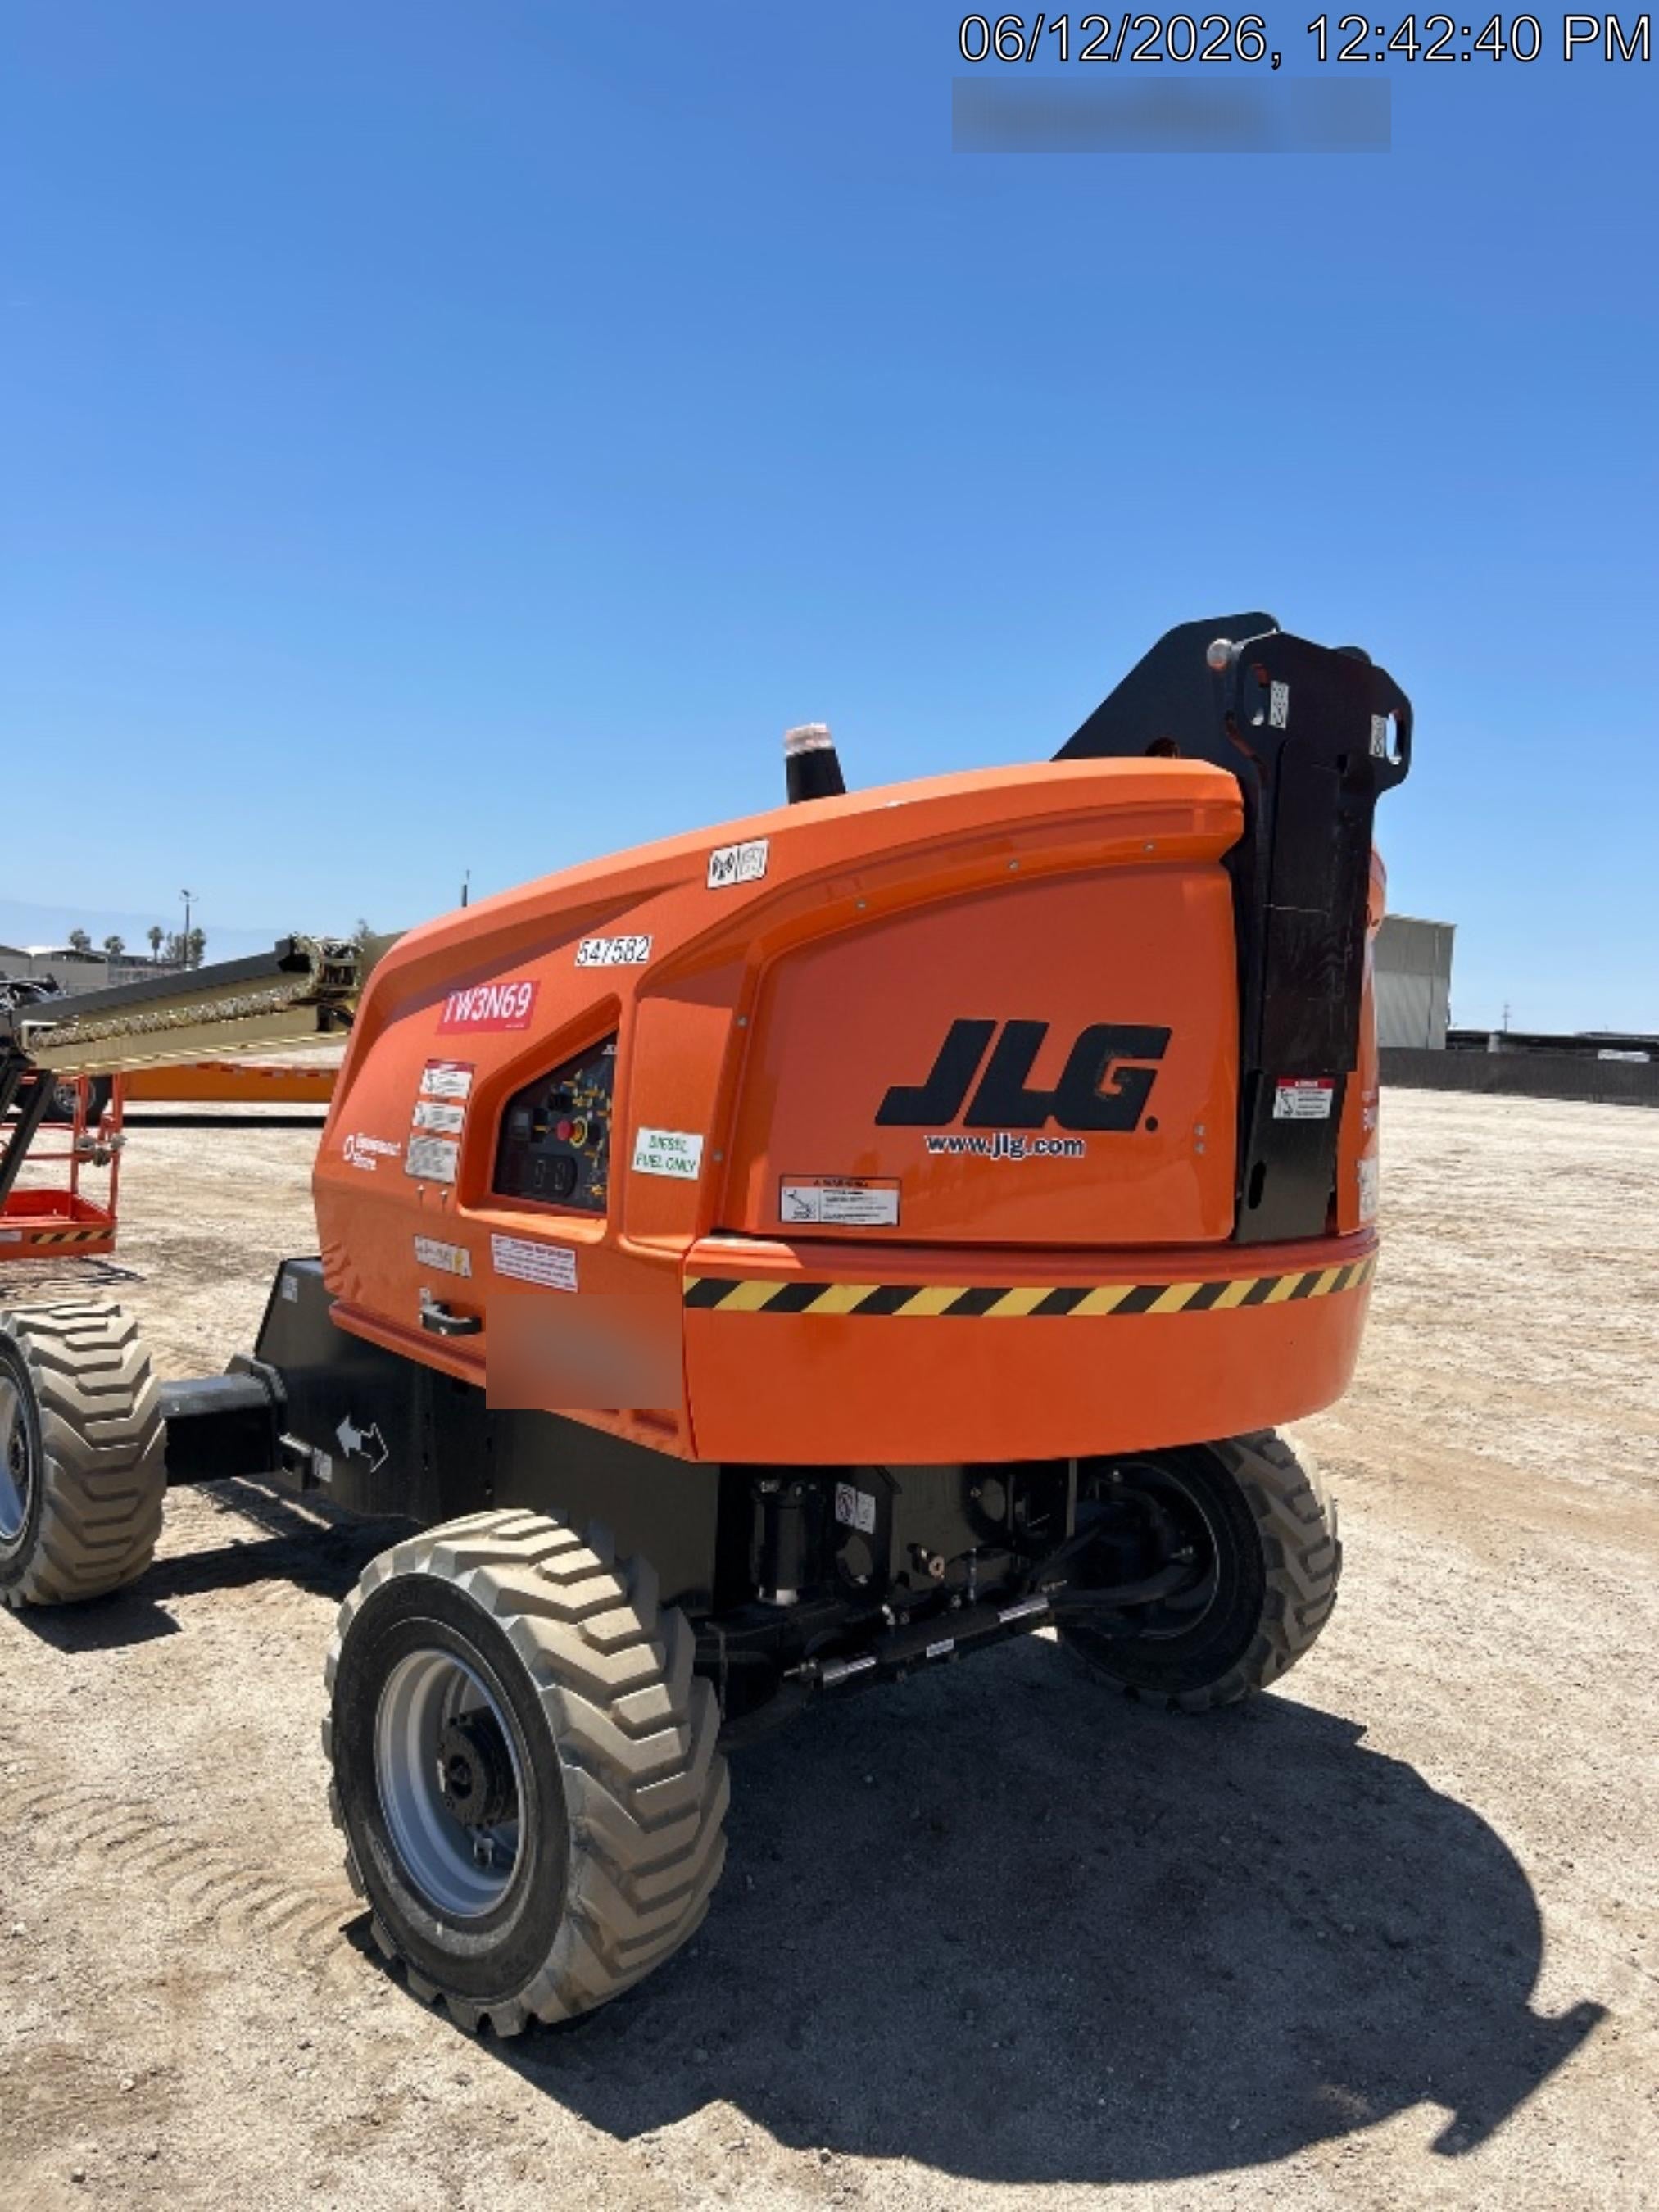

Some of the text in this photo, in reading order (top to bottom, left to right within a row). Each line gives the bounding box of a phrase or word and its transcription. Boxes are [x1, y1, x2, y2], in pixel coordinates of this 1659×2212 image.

[577, 936, 650, 965] 547582
[648, 1135, 687, 1153] DIESEL
[924, 1133, 1085, 1160] www.jlg.com
[636, 1153, 696, 1172] FUEL ONLY
